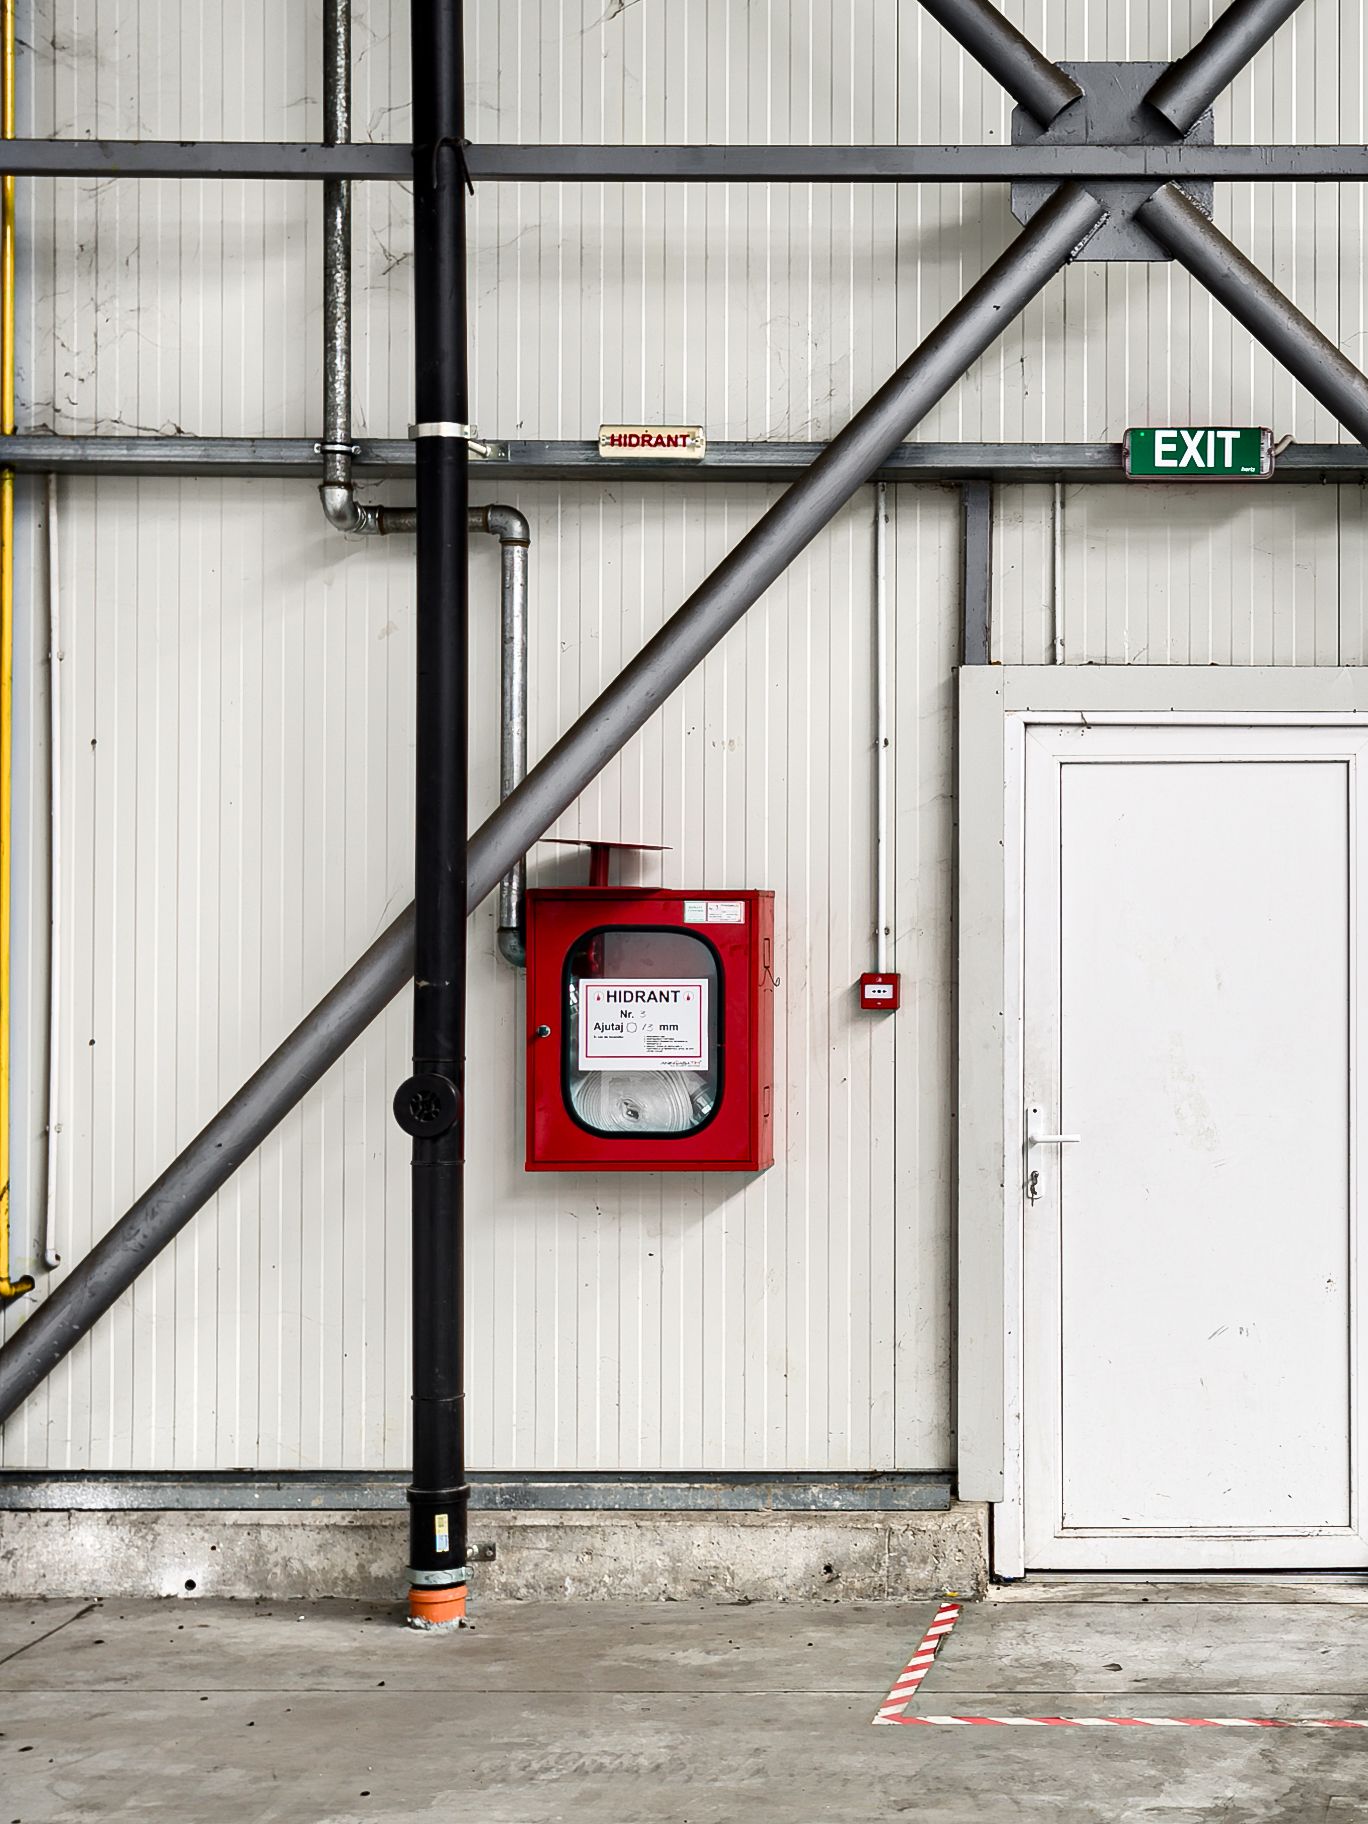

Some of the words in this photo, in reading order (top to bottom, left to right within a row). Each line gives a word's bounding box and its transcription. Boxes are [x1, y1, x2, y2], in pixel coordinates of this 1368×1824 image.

[609, 433, 690, 448] HIDRANT
[1154, 430, 1241, 468] EXIT
[606, 990, 681, 1003] HIDRANT
[620, 1009, 634, 1018] Nr.
[593, 1022, 624, 1033] Ajutaj
[659, 1023, 679, 1031] mm
